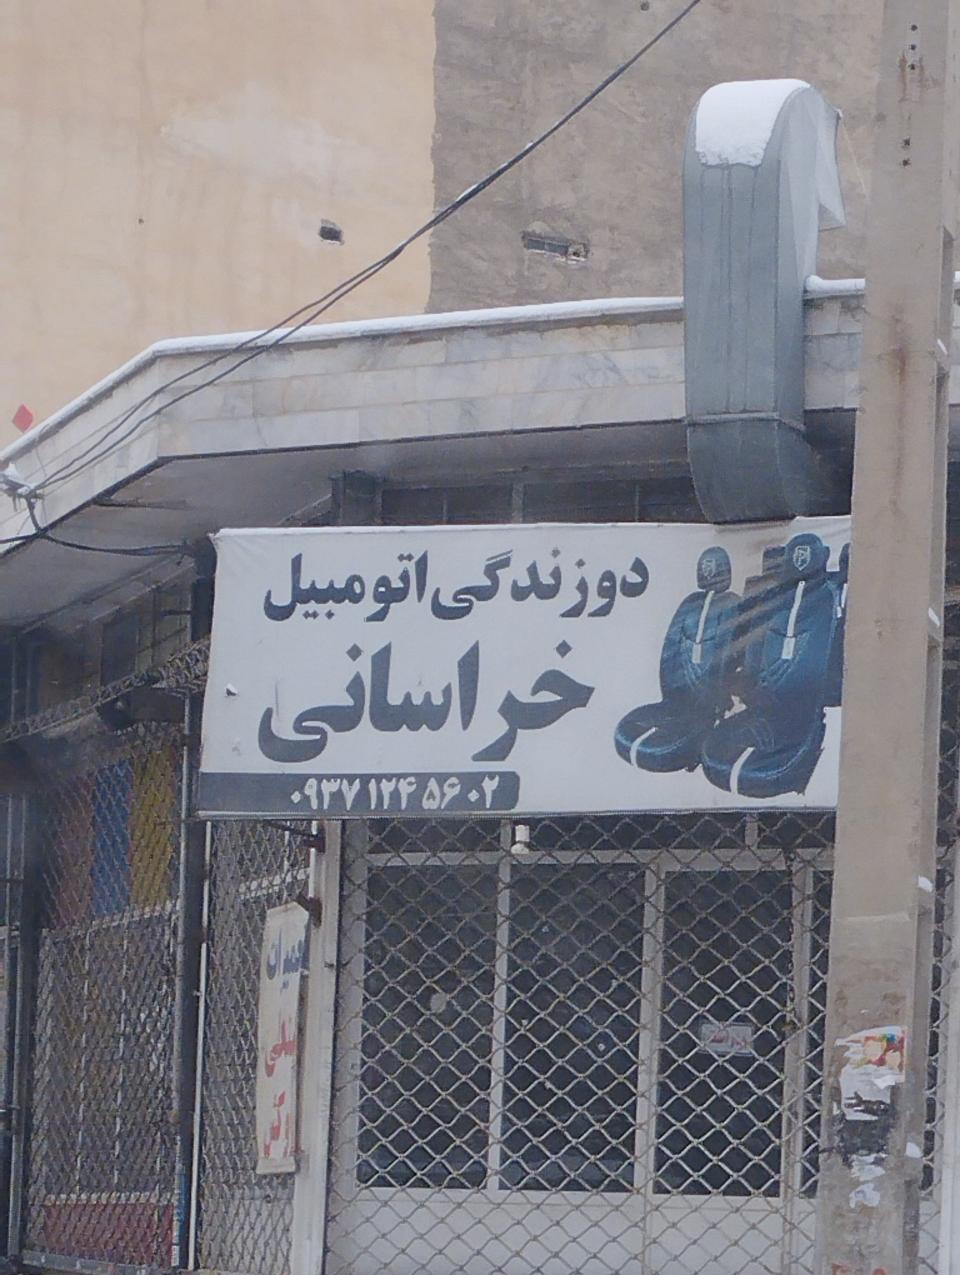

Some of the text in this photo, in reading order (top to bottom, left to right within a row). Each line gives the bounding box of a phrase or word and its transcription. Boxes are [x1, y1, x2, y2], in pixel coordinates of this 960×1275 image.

[263, 547, 650, 622] دوزندگی اتومبیل
[257, 639, 597, 764] خراسانی
